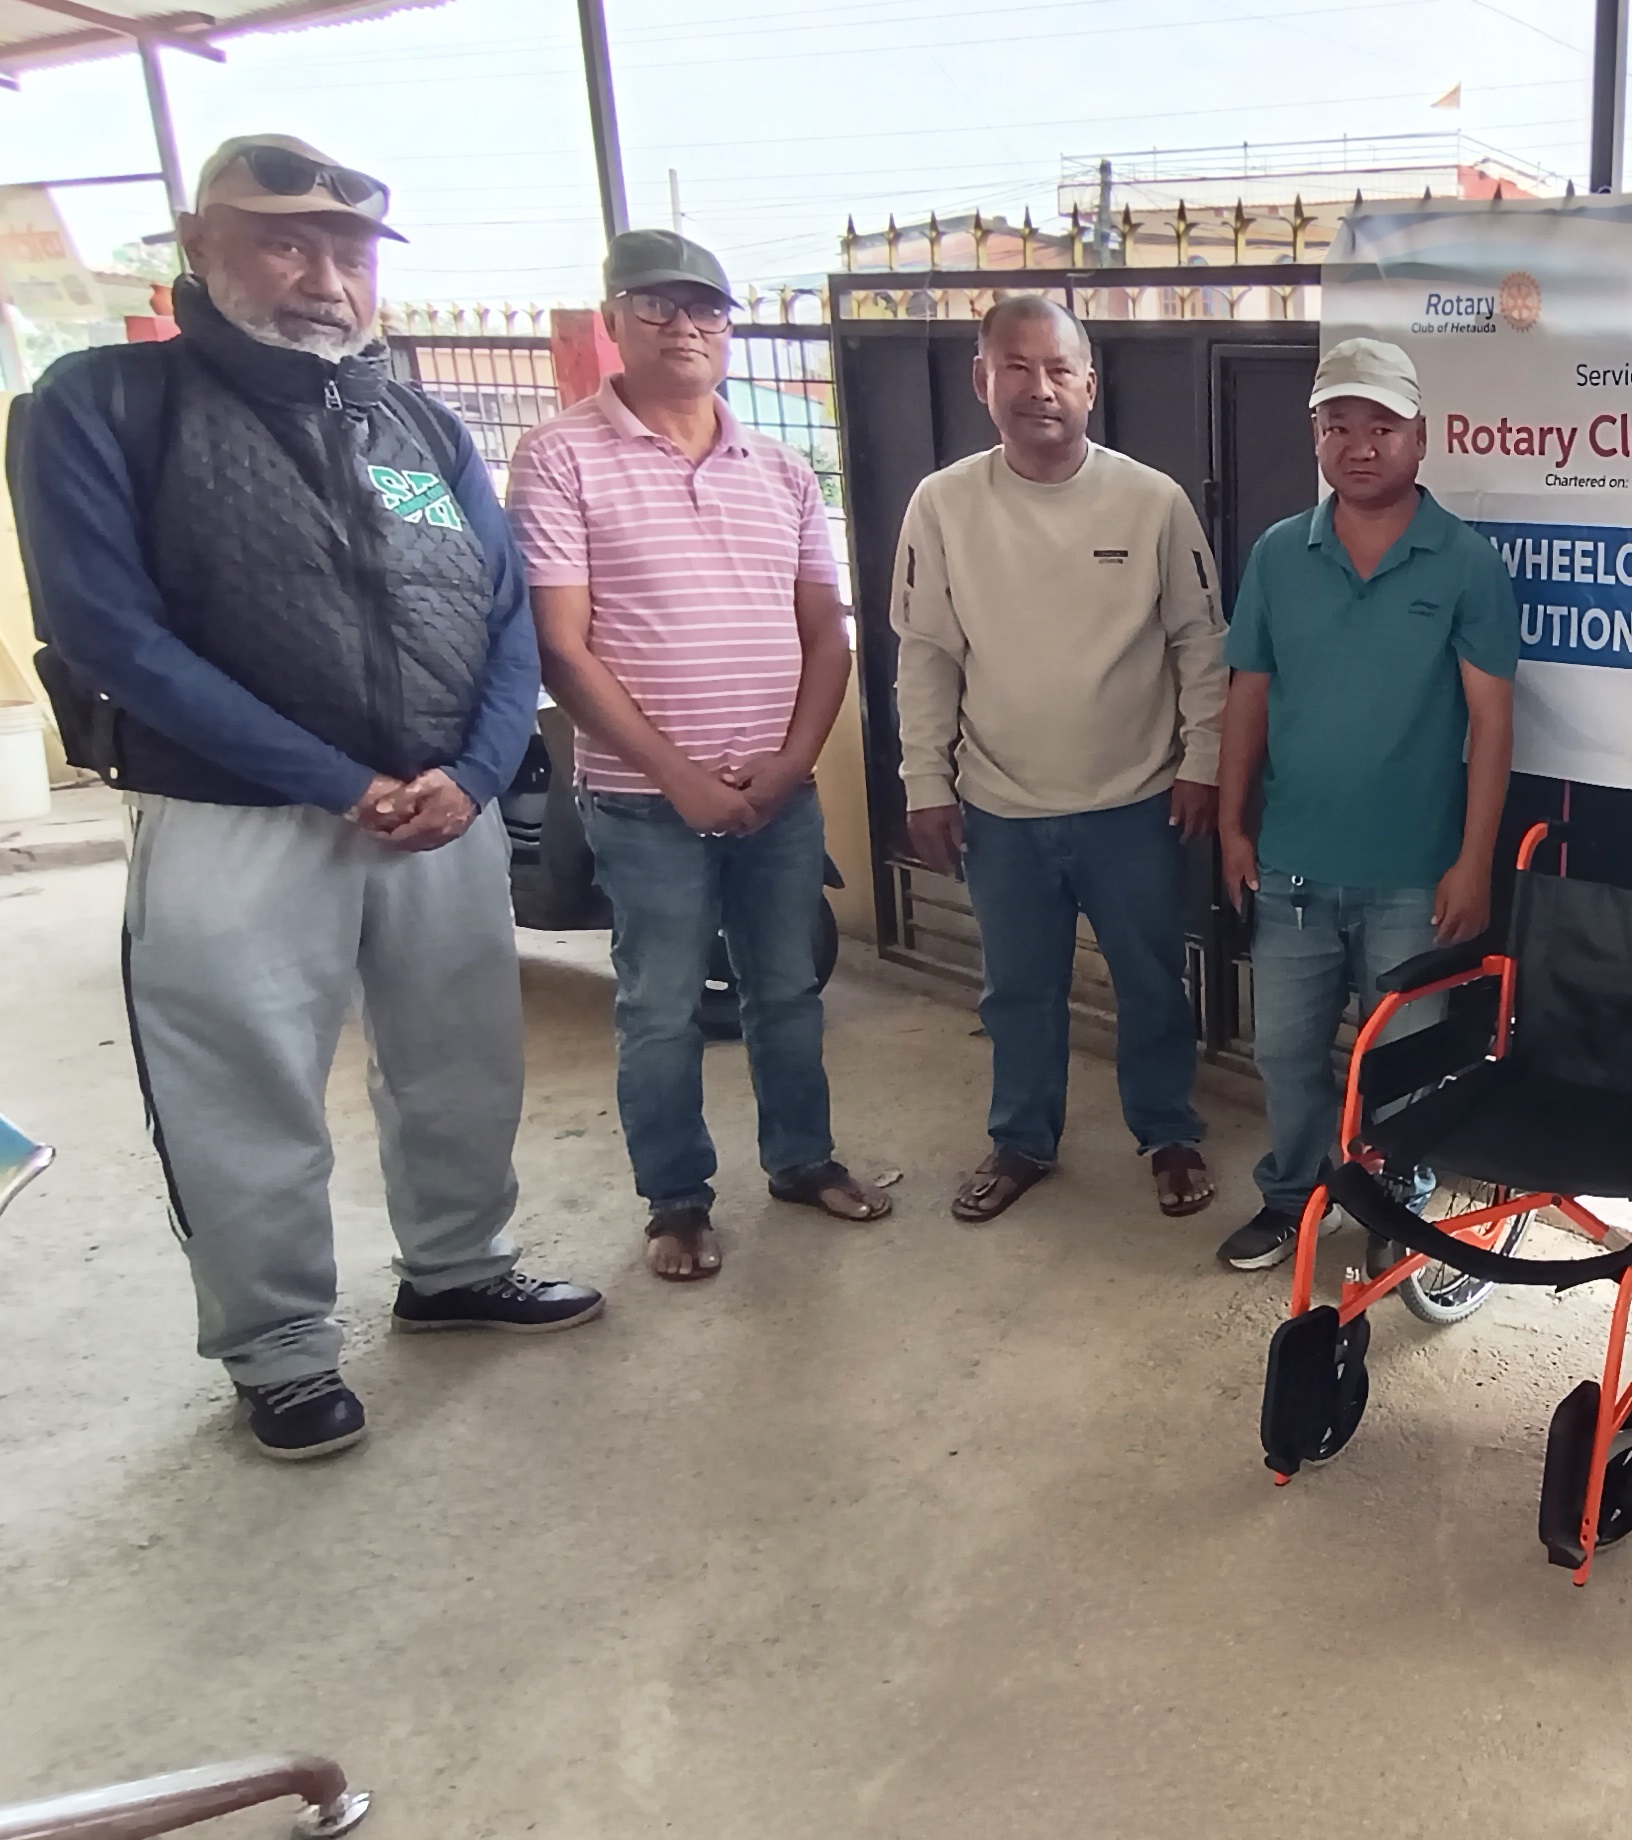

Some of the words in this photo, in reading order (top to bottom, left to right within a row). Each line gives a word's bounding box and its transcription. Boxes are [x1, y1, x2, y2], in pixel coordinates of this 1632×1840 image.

[1426, 293, 1494, 320] Rotary
[1411, 322, 1434, 333] Club
[1437, 321, 1449, 333] of
[1450, 321, 1496, 334] Hetauda
[1447, 414, 1578, 468] Rotary
[1545, 473, 1606, 488] Chartered
[1608, 478, 1629, 489] on:
